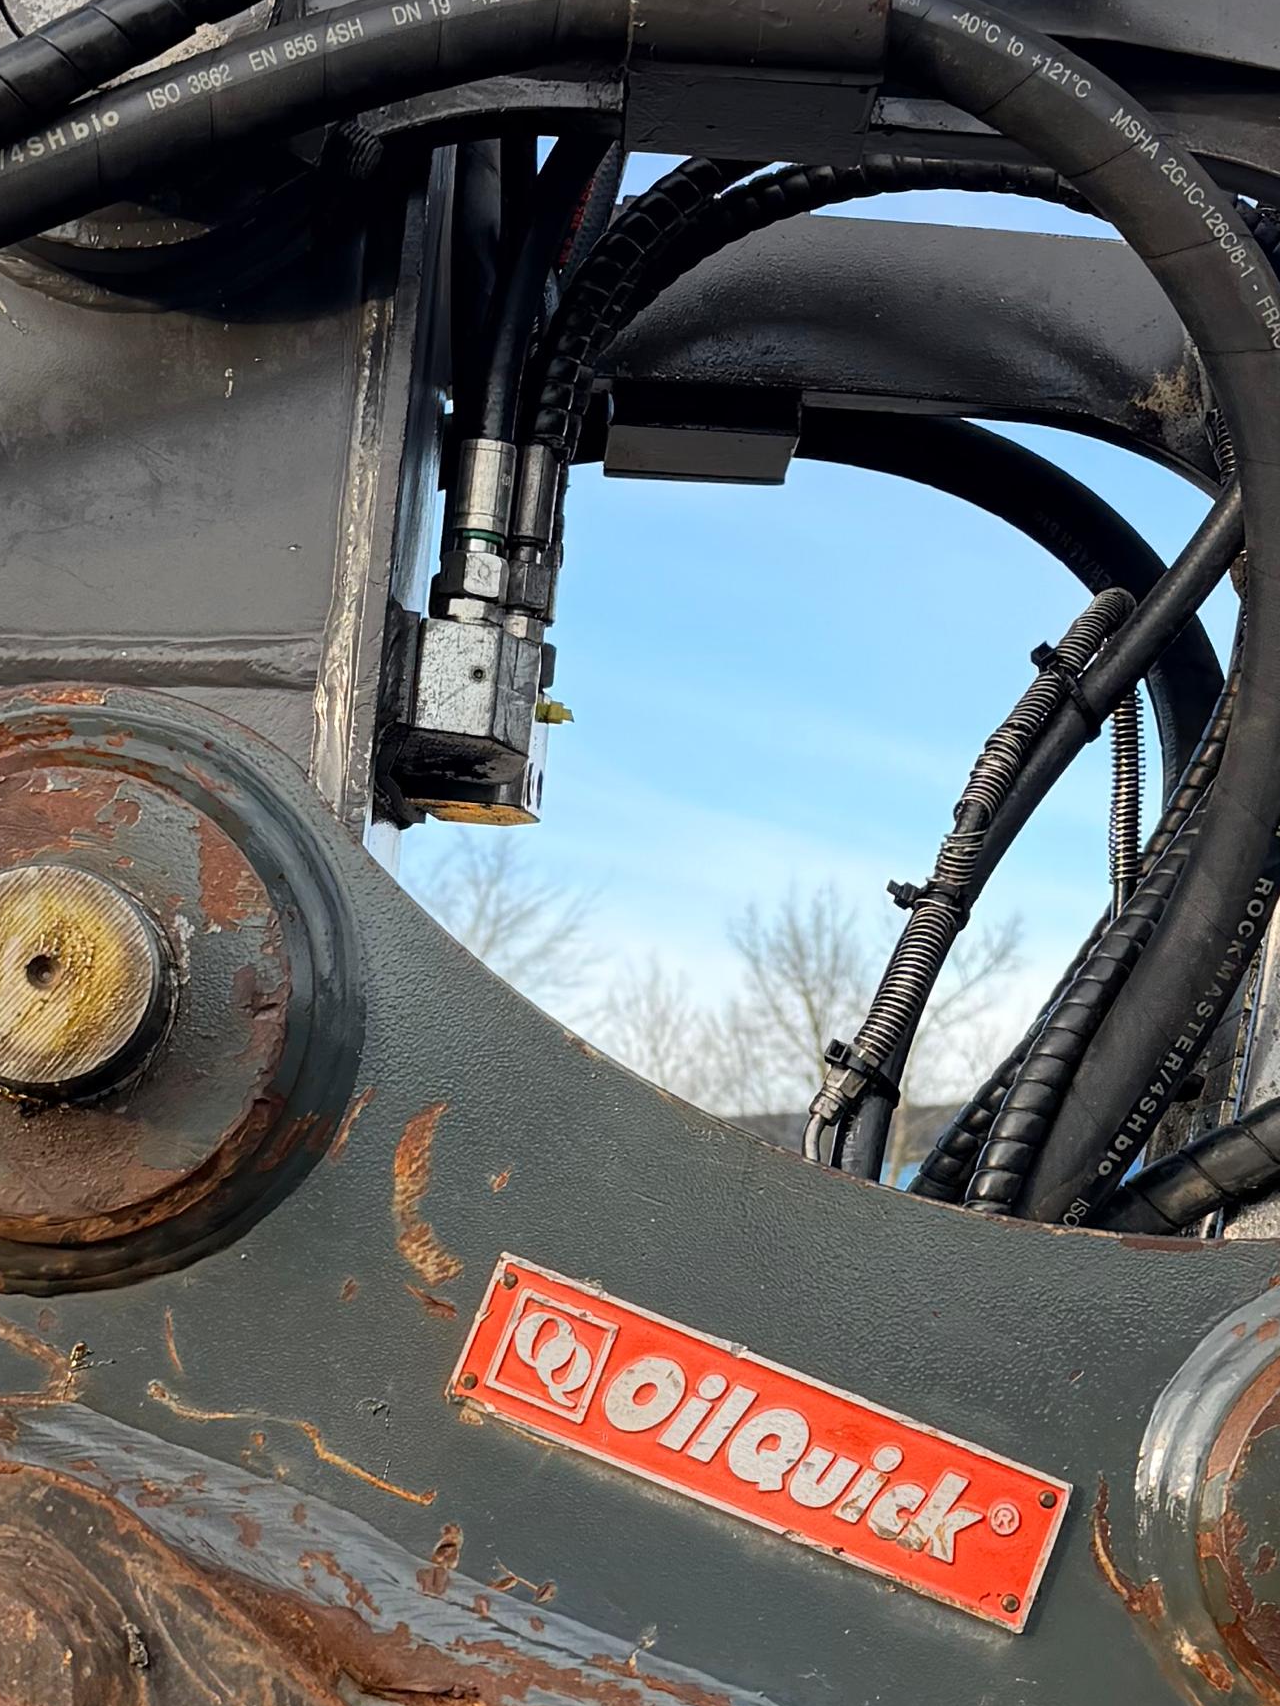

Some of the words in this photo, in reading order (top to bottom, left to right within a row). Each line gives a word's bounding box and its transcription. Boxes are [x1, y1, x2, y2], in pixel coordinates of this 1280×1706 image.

[145, 85, 182, 113] ISO
[187, 63, 233, 96] 3862
[248, 47, 278, 73] EN
[284, 33, 319, 62] 856
[325, 17, 366, 48] 4SH
[391, 2, 422, 27] DN
[1006, 35, 1025, 59] to
[1109, 106, 1162, 162] MSHA
